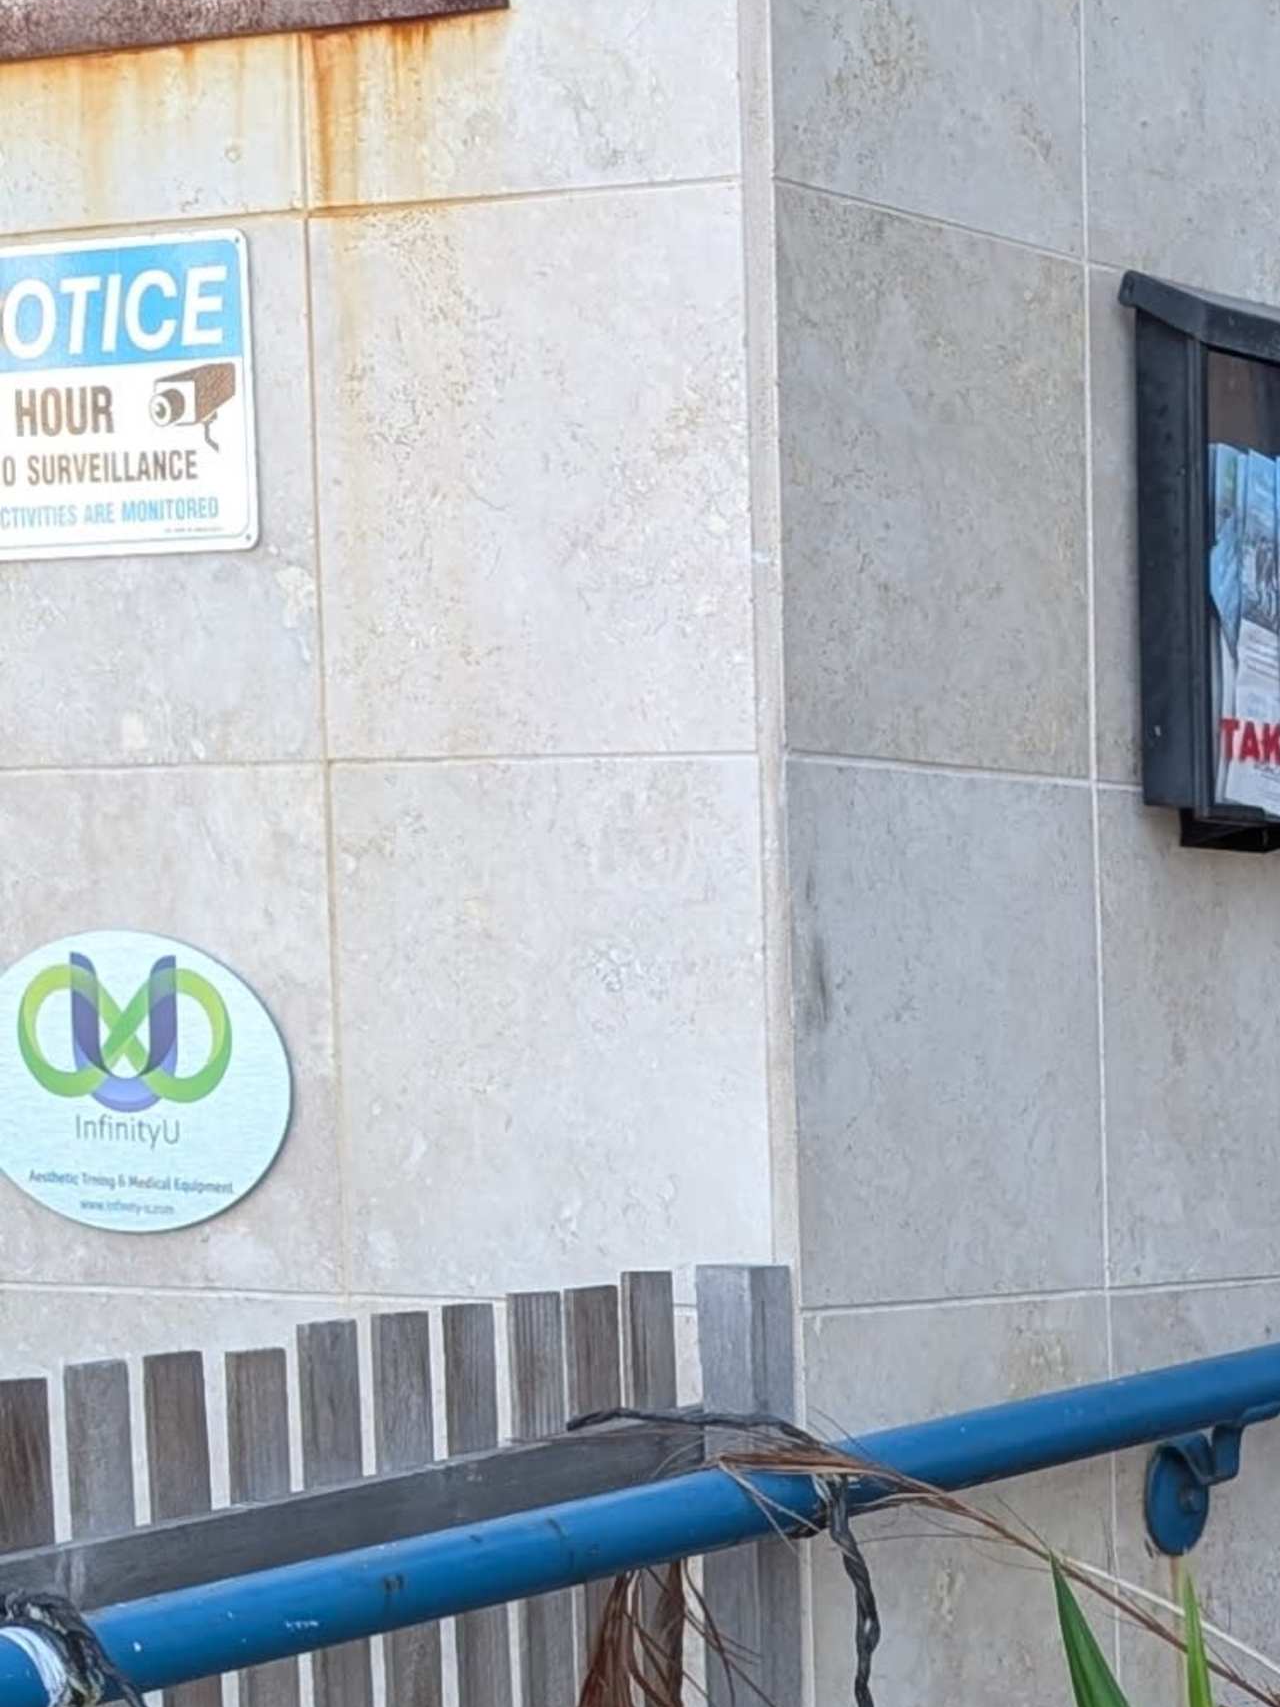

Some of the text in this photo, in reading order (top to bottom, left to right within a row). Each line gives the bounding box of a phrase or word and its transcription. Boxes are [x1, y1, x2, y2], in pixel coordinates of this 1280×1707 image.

[14, 385, 115, 438] HOUR
[27, 449, 199, 487] SURVEILLANCE
[83, 501, 116, 525] ARE
[121, 496, 220, 524] MONITORED
[74, 1113, 181, 1151] InfinityU
